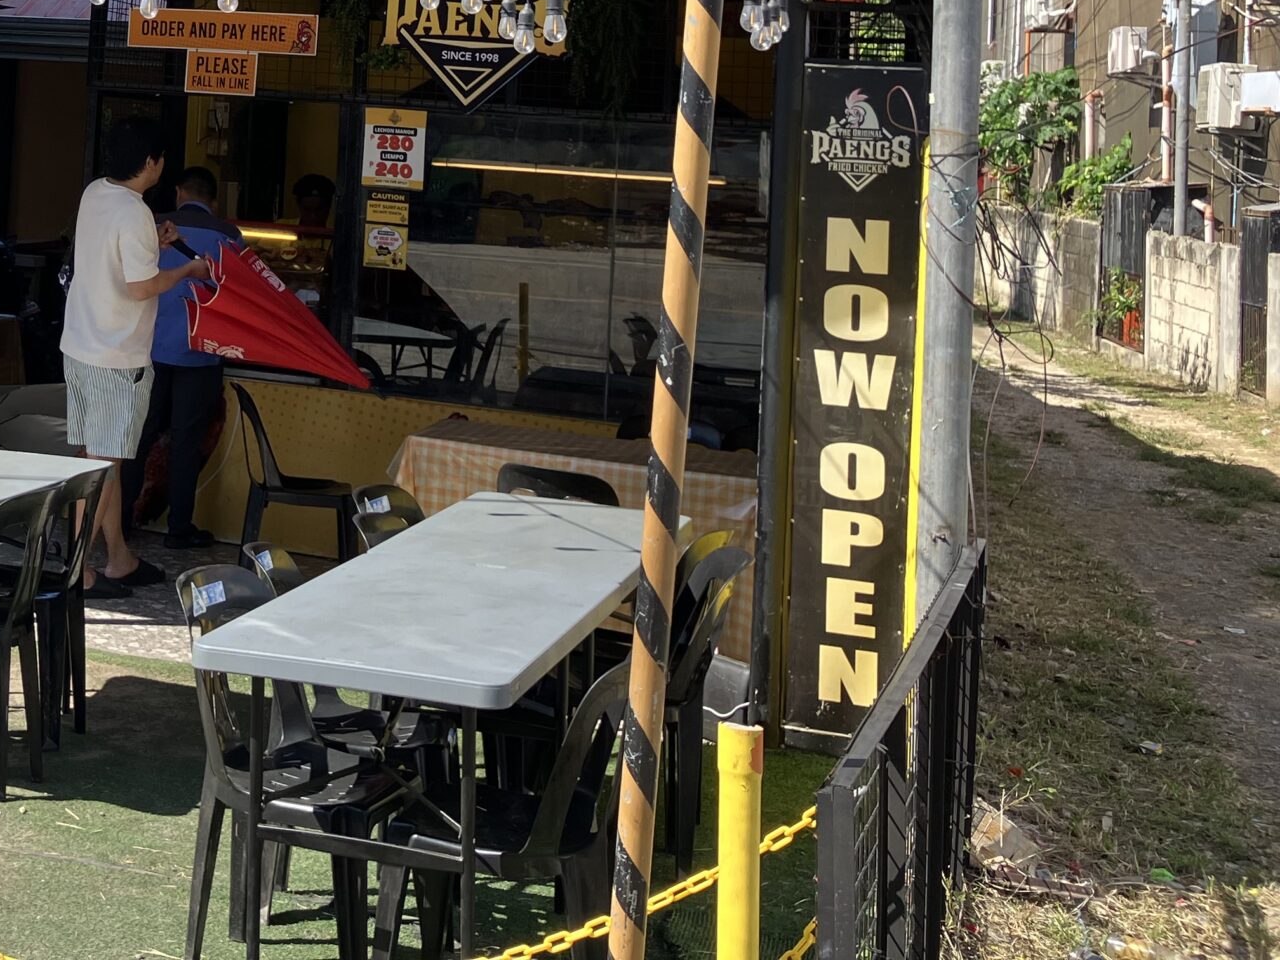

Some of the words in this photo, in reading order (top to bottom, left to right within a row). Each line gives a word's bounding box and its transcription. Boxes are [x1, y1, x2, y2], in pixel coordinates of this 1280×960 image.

[141, 19, 185, 37] ORDER
[189, 21, 216, 39] AND
[221, 23, 247, 40] PAY
[251, 25, 287, 42] HERE
[196, 56, 249, 76] PLEASE
[441, 50, 472, 62] SINCE
[474, 52, 500, 64] 1998
[191, 75, 213, 88] FALL
[216, 77, 225, 88] IN
[228, 77, 250, 90] LINE
[837, 128, 851, 137] THE
[852, 128, 883, 138] ORIGINAL
[376, 134, 414, 152] 280
[810, 130, 911, 168] PAENGS
[375, 161, 413, 179] 240
[828, 161, 850, 172] FRIED
[853, 163, 888, 174] CHICKEN
[371, 192, 406, 201] CAUTION
[814, 216, 896, 411] NOW
[818, 441, 886, 708] OPEN
